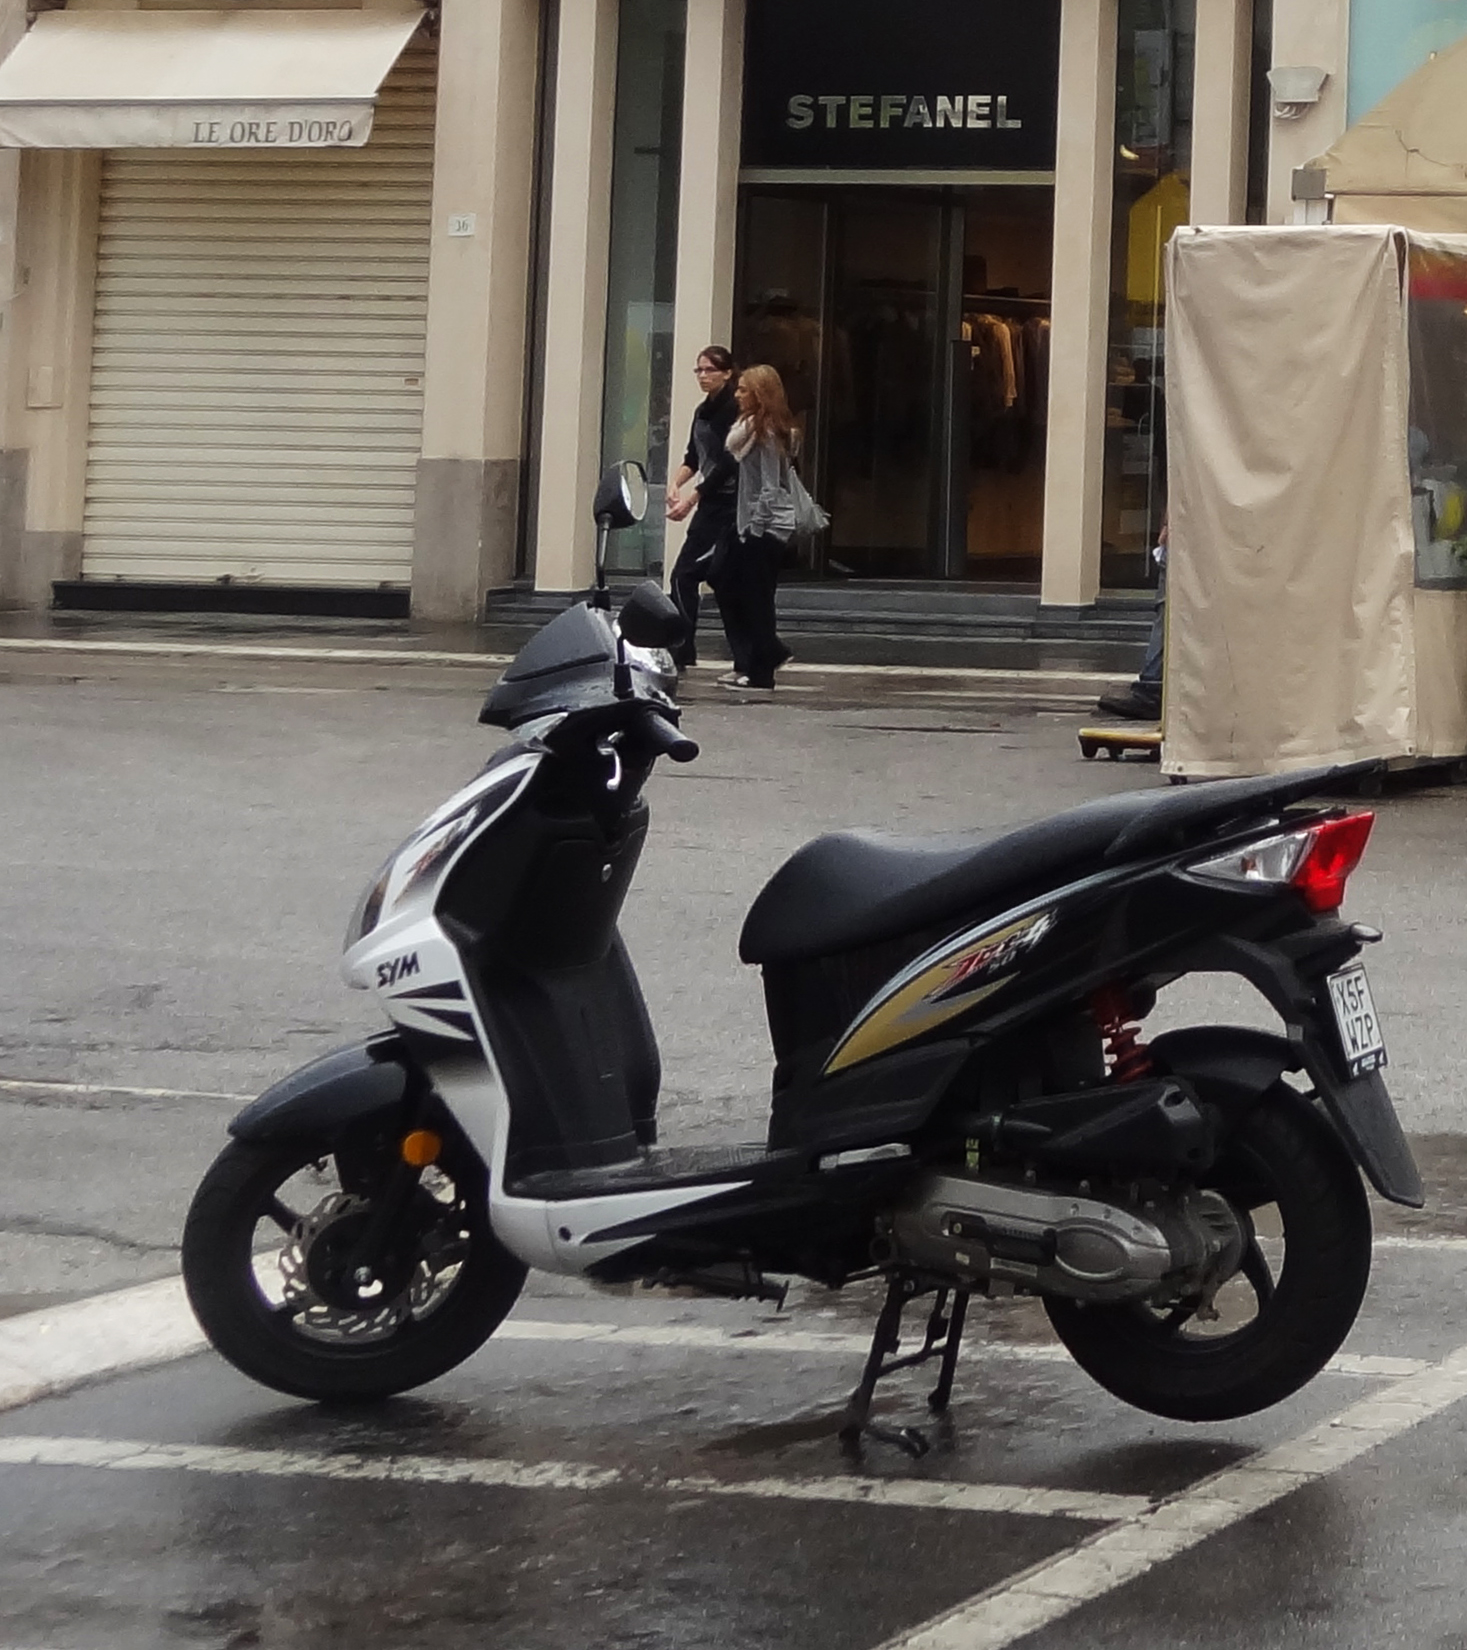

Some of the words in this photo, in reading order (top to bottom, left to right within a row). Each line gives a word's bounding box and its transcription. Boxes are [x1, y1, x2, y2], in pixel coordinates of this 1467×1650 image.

[786, 94, 1022, 129] STEFANEL
[193, 121, 221, 143] LE
[229, 120, 277, 143] ORE
[287, 119, 353, 143] D'ORO
[376, 950, 421, 989] SYM
[1335, 975, 1365, 1017] X5F
